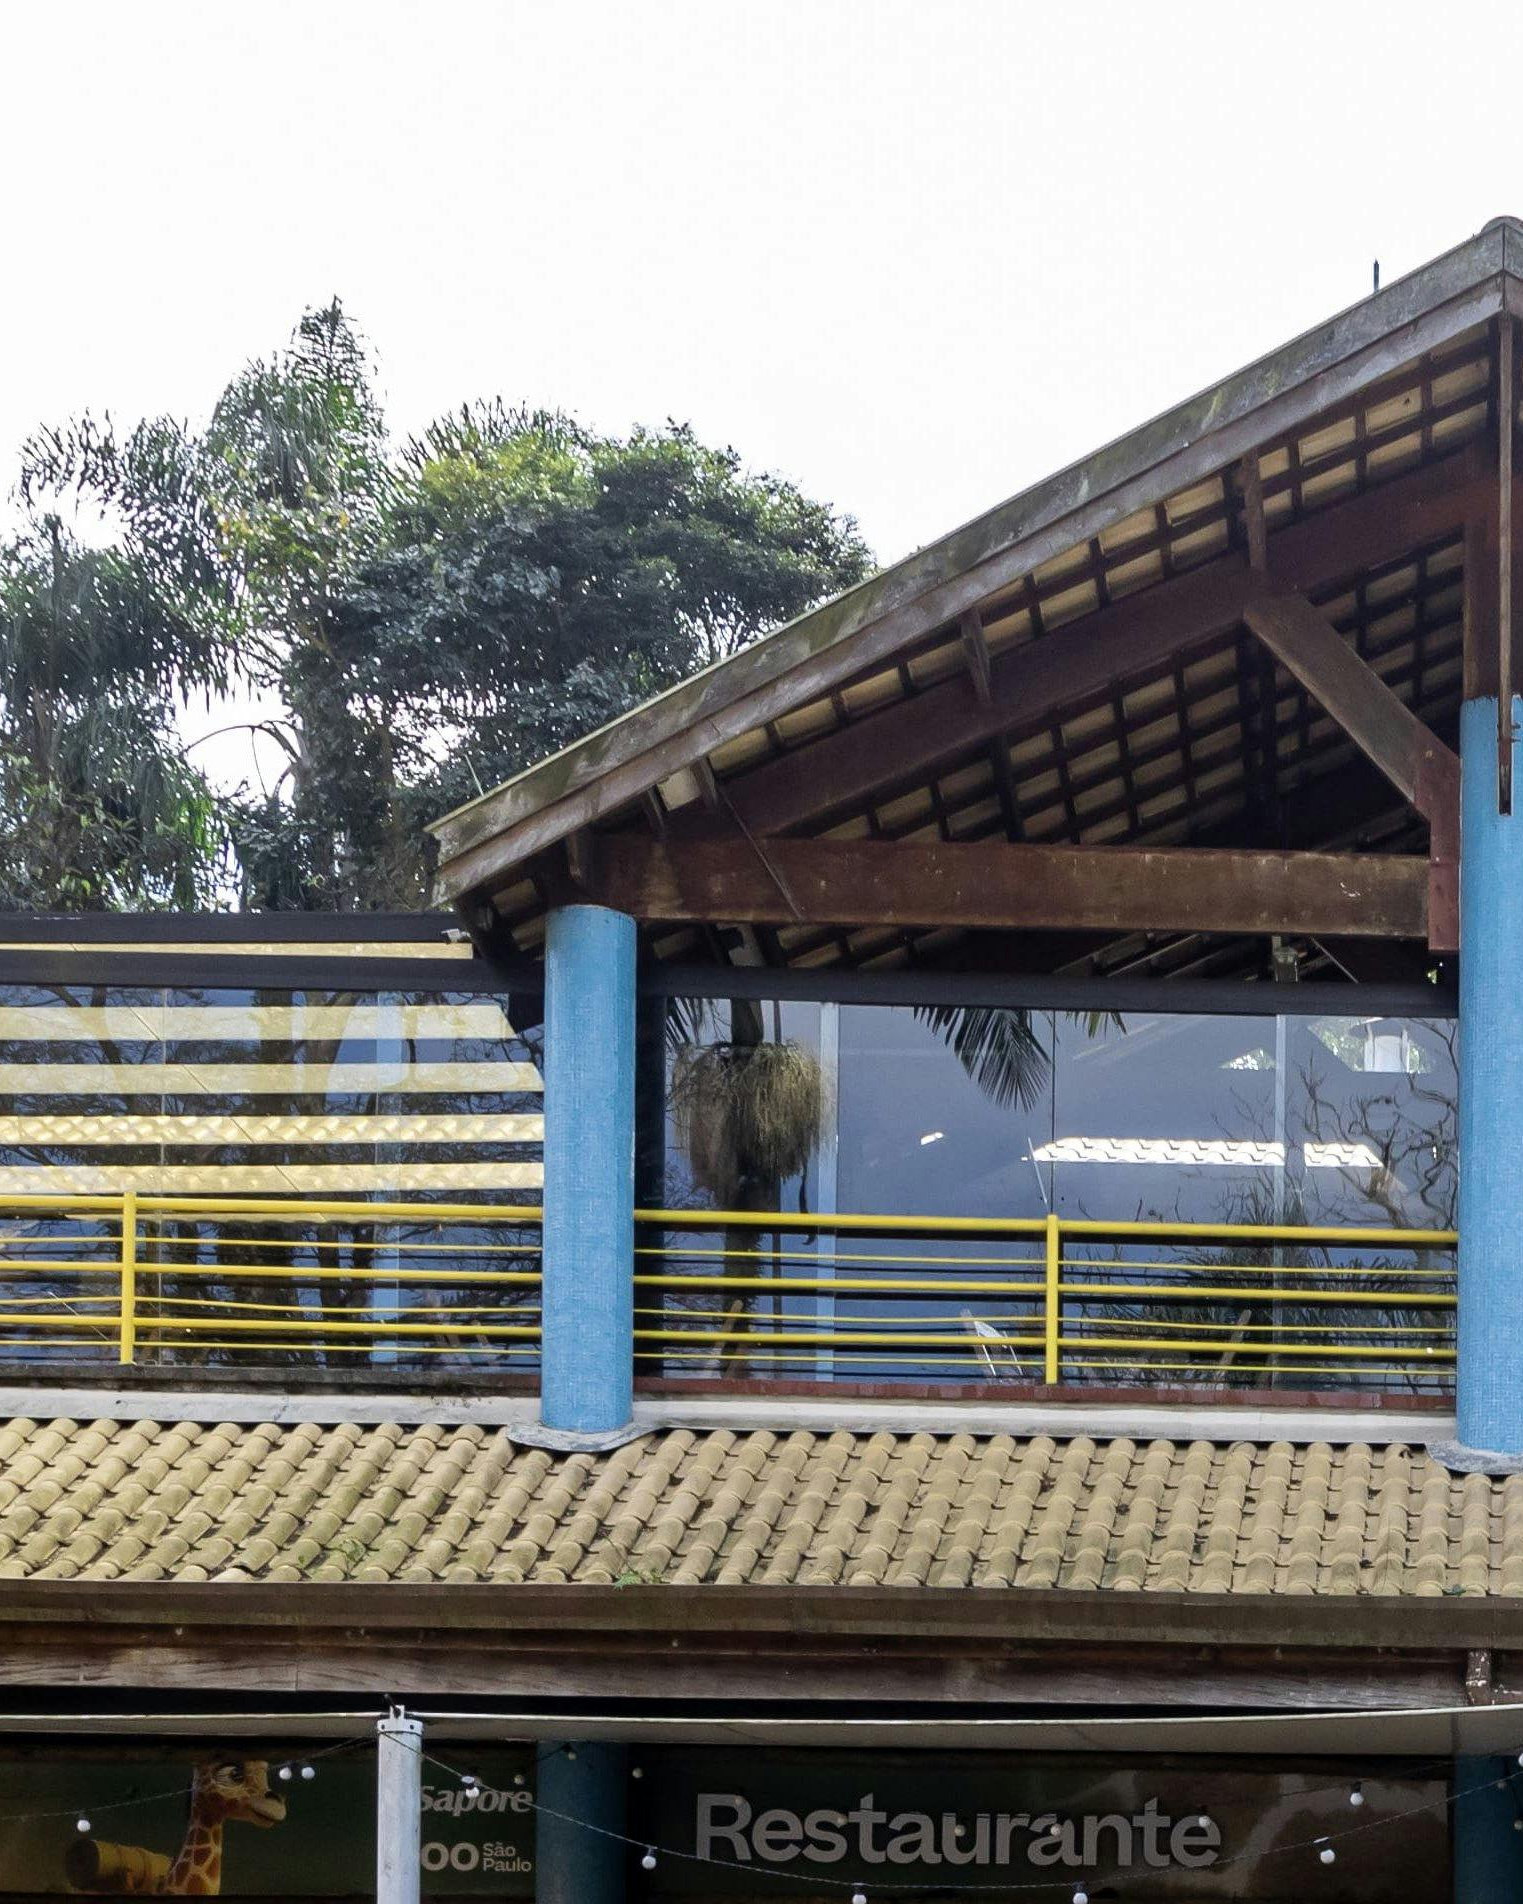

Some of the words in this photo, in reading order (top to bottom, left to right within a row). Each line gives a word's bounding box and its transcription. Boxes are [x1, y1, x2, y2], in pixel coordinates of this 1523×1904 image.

[695, 1792, 1223, 1867] Restaurante
[420, 1841, 480, 1872] oo
[482, 1841, 516, 1857] São
[482, 1857, 533, 1873] Paulo
